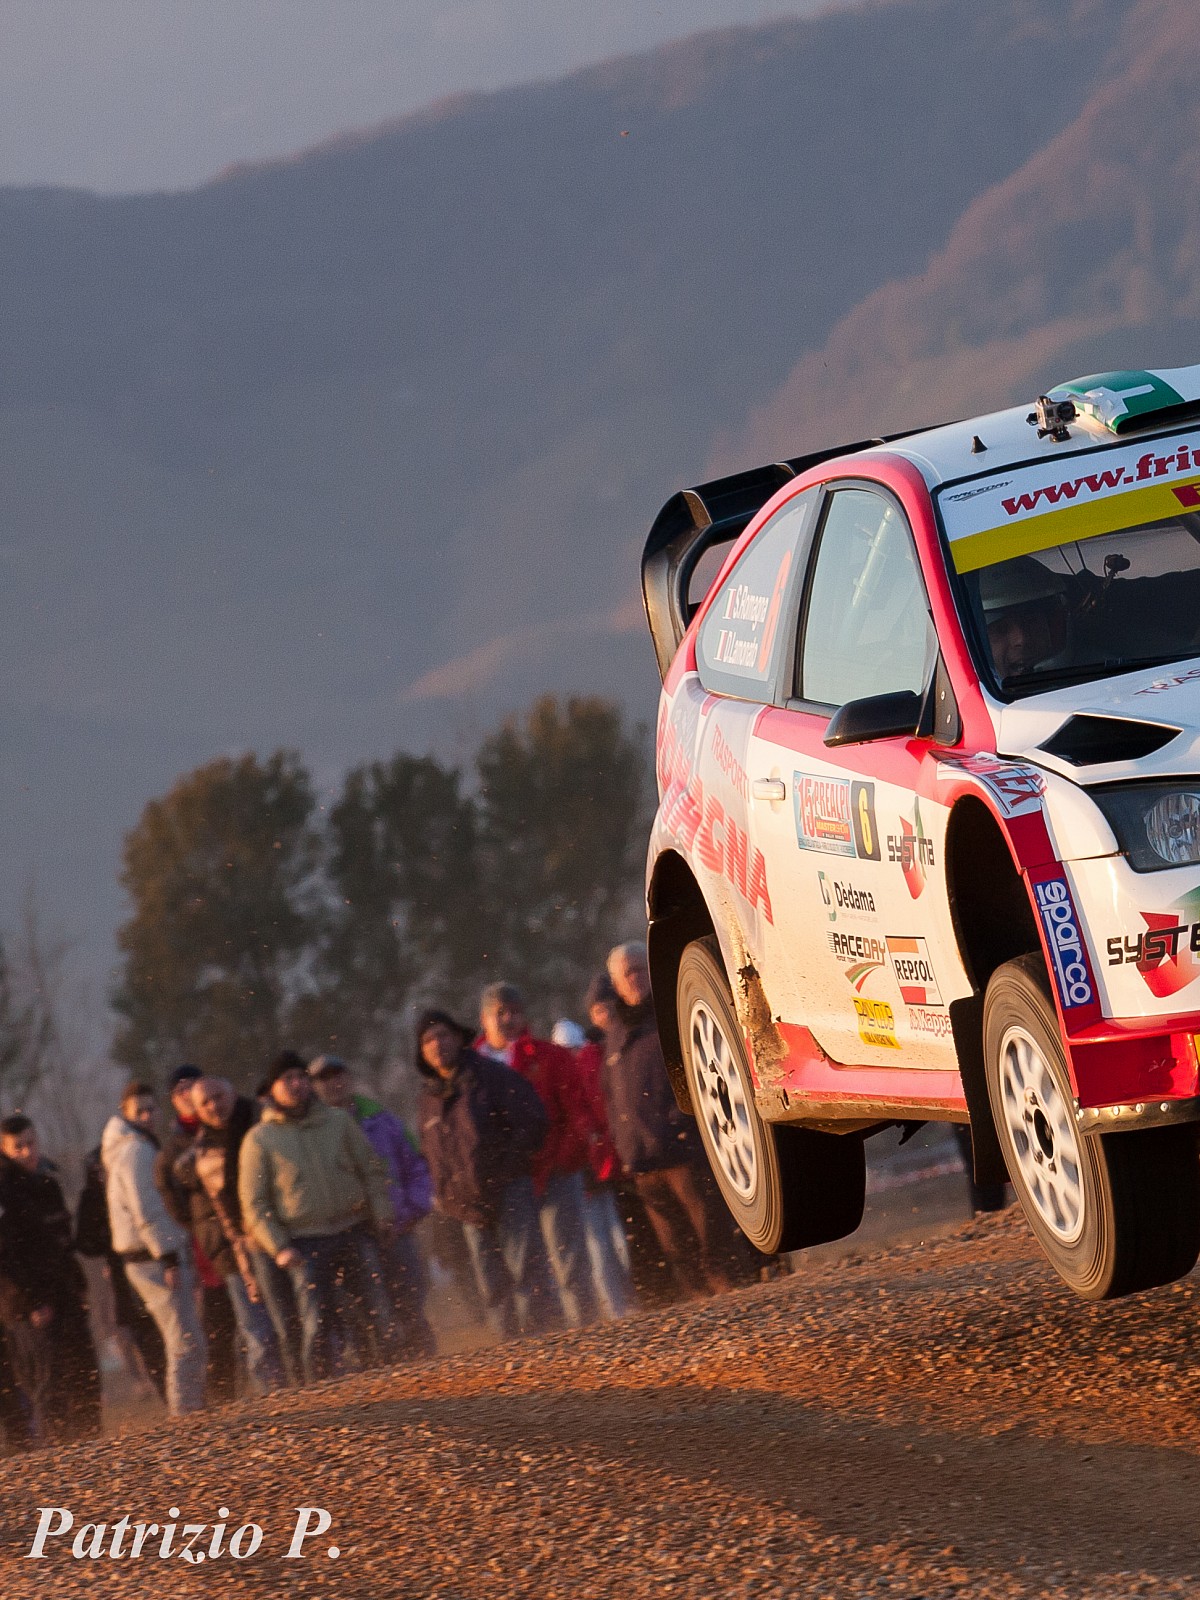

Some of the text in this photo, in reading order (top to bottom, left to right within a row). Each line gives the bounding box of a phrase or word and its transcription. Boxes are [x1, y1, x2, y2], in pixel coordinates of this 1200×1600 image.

[858, 787, 873, 855] 6
[832, 931, 887, 966] RACEDAY
[1042, 881, 1092, 1005] sparco
[894, 959, 934, 982] REPSOL
